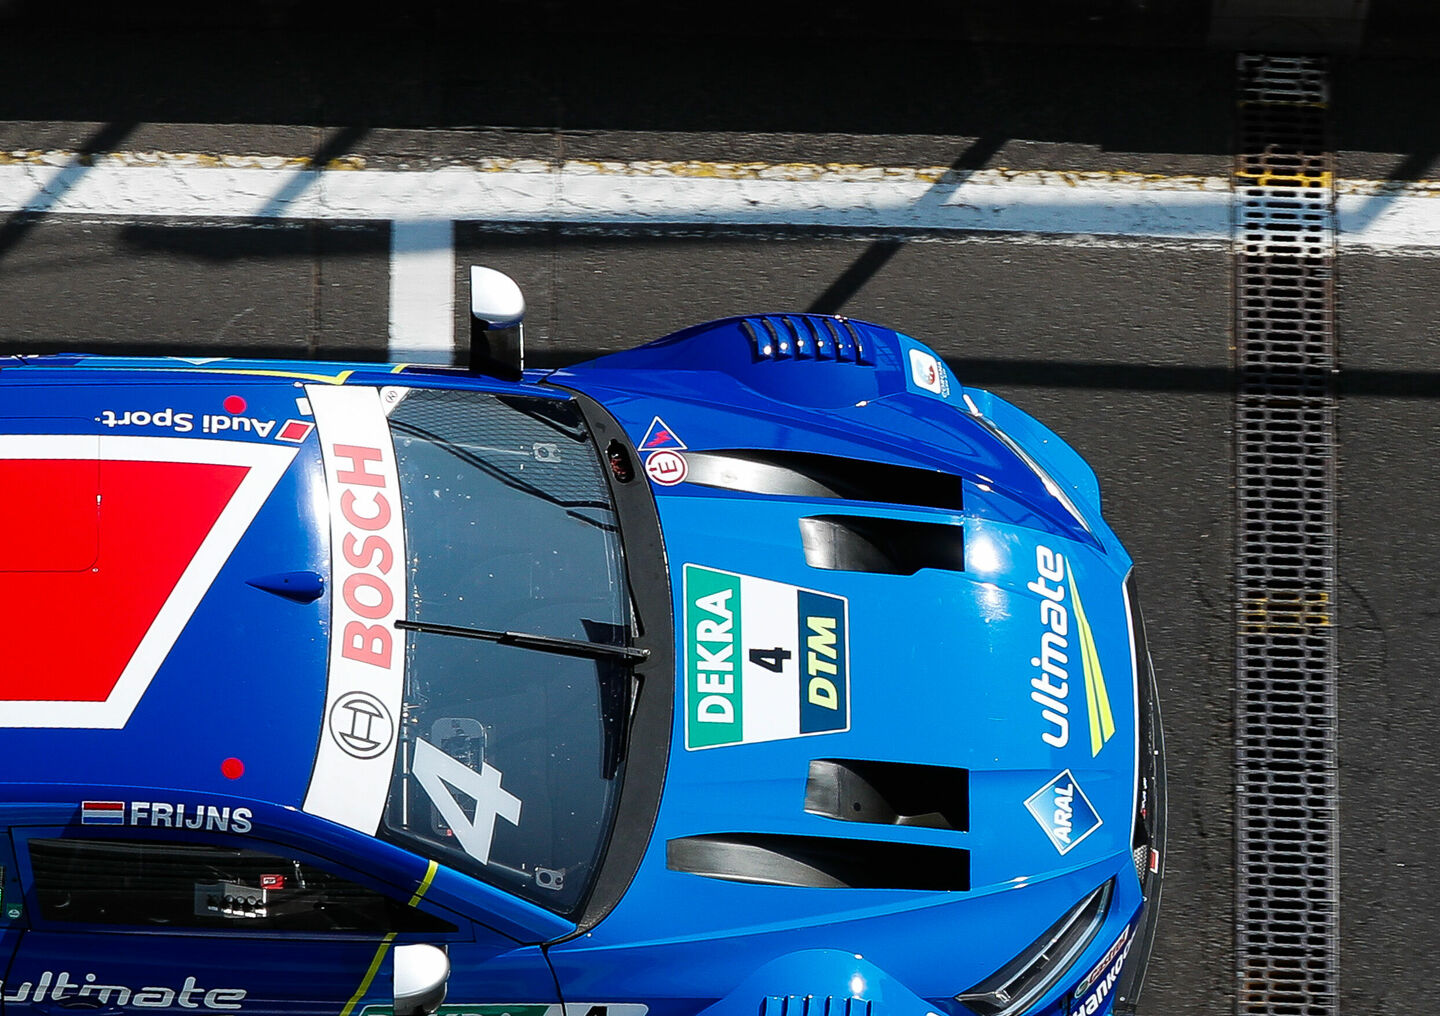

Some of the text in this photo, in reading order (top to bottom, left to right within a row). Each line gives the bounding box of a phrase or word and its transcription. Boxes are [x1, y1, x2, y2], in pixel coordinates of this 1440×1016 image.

[102, 408, 277, 438] Audi Sport
[334, 443, 394, 670] BOSCH
[696, 587, 735, 725] DEKRA
[748, 647, 792, 673] 4
[806, 615, 838, 711] DTM
[1027, 544, 1070, 748] ultimate
[131, 800, 253, 833] FRIJNS
[411, 733, 523, 866] 4
[1051, 783, 1076, 844] ARAL
